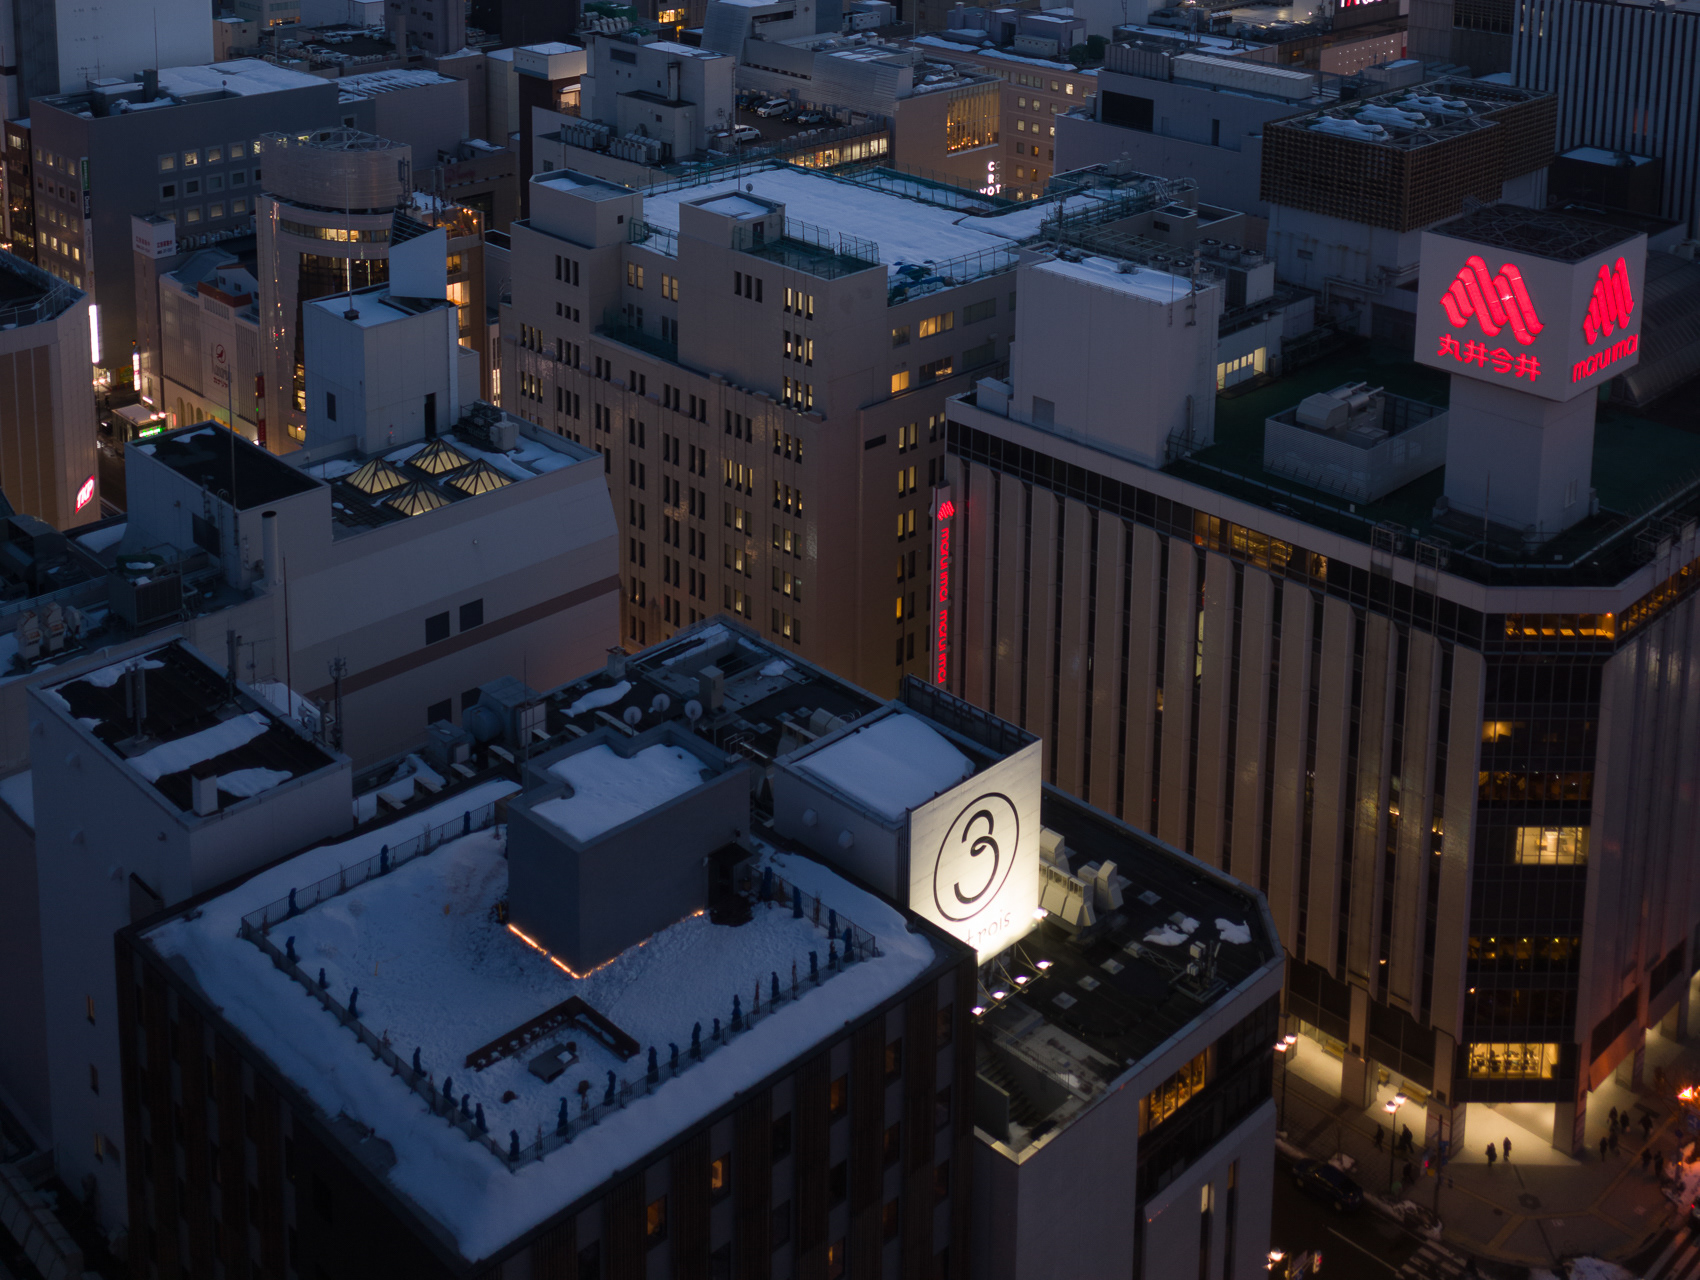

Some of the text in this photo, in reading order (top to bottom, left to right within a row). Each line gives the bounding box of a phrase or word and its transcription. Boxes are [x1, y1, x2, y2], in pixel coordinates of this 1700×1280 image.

[1437, 333, 1542, 382] 丸井今井
[77, 478, 95, 509] TKP
